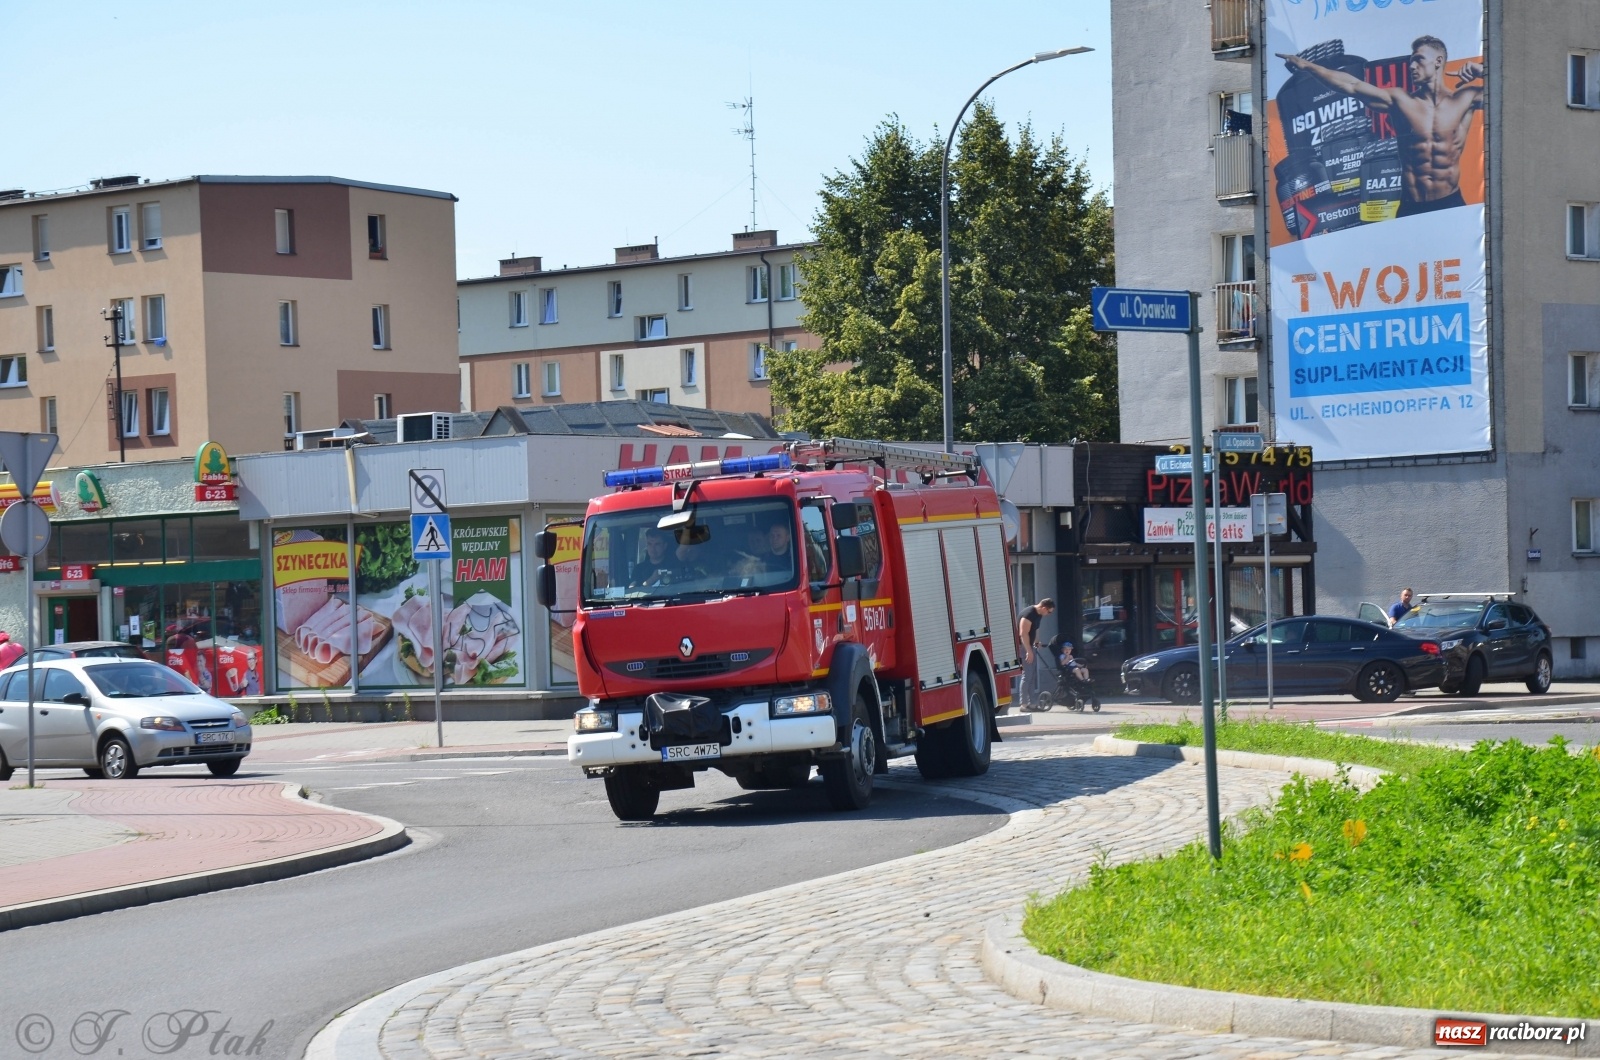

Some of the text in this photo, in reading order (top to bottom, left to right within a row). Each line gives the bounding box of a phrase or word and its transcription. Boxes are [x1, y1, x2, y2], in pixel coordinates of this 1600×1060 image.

[1292, 110, 1316, 134] ISO
[1366, 178, 1387, 190] EAA
[1291, 258, 1462, 313] TWOJE
[1120, 296, 1176, 325] ul. Opawska
[1292, 312, 1463, 355] CENTRUM
[1294, 355, 1465, 385] SUPLEMENTACJI
[1289, 394, 1474, 421] UL. EICHENDORFFA 12
[1233, 437, 1255, 448] Opawska
[1170, 461, 1207, 470] Eichena
[1283, 448, 1312, 467] 75
[205, 490, 227, 499] 6-23
[1147, 470, 1312, 505] Piza Wrld
[453, 526, 508, 538] KRÓLEWSKIE
[1147, 520, 1174, 536] Zamów
[1177, 518, 1195, 536] Pizz
[461, 541, 500, 553] WĘDLINY
[276, 552, 348, 571] SZYNECZKA
[455, 557, 508, 582] HAM
[66, 570, 83, 578] 6-23
[668, 744, 718, 758] SRC 4W75
